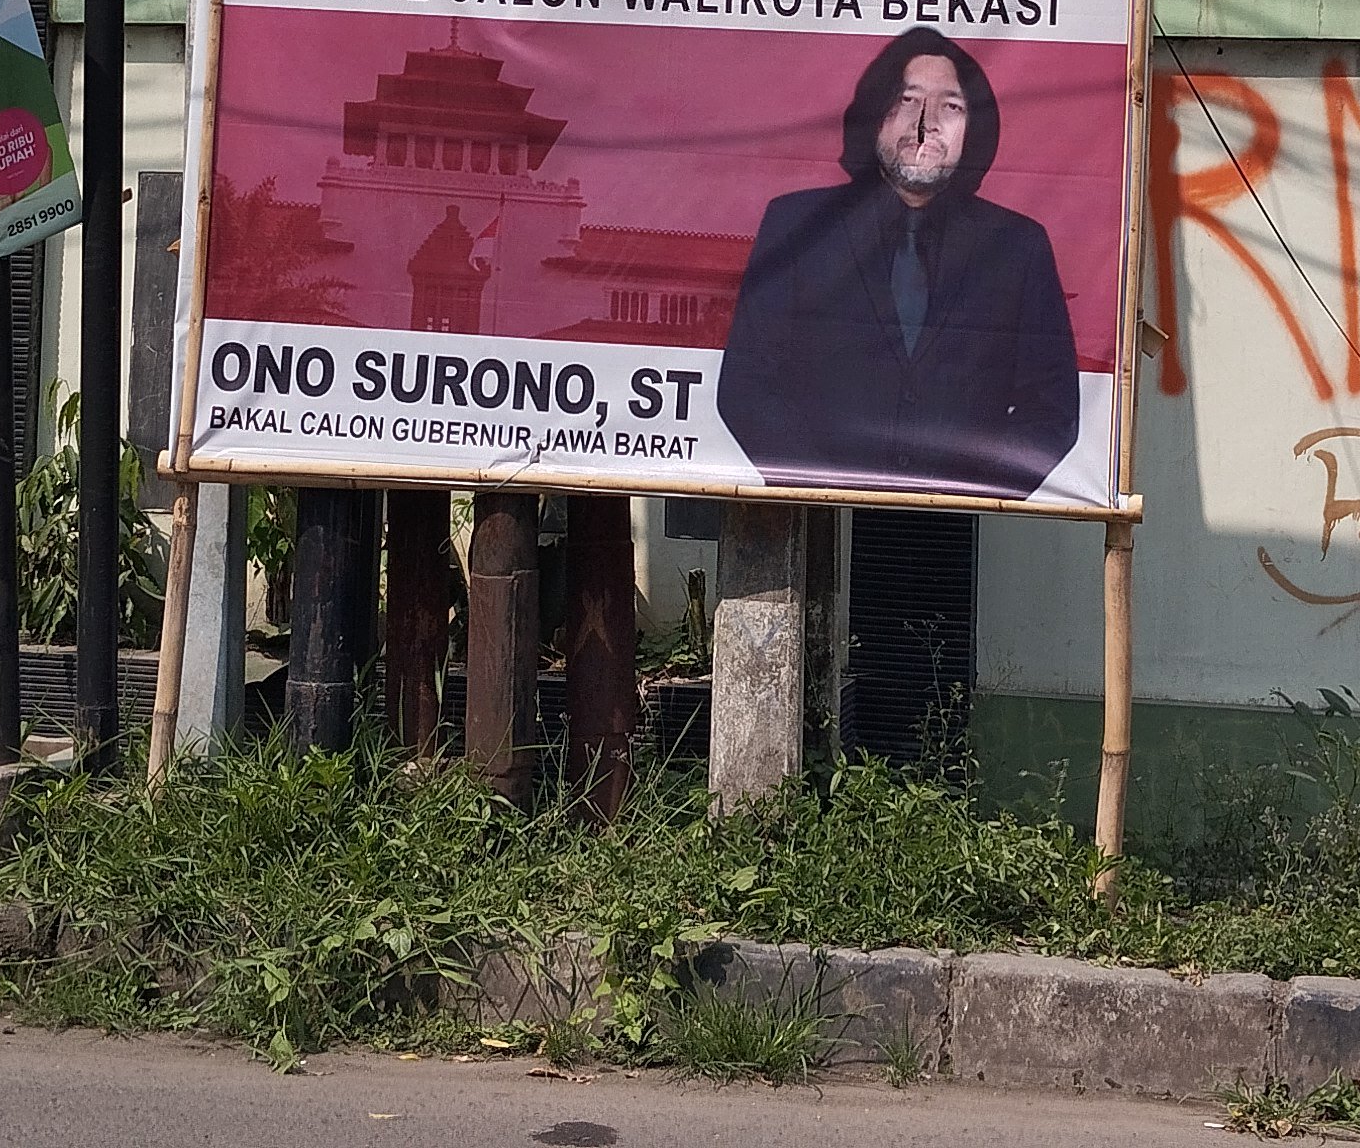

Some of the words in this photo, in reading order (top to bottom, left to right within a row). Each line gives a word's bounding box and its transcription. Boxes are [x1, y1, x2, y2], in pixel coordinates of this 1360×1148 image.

[7, 131, 34, 153] RIBU
[9, 124, 24, 138] dari
[211, 342, 335, 397] ONO
[352, 350, 609, 428] SURONO,
[627, 367, 703, 420] ST
[209, 406, 292, 434] BAKAL
[300, 411, 385, 438] CALON
[392, 418, 532, 452] GUBERNUR
[537, 429, 607, 455] JAWA
[613, 432, 699, 460] BARAT
